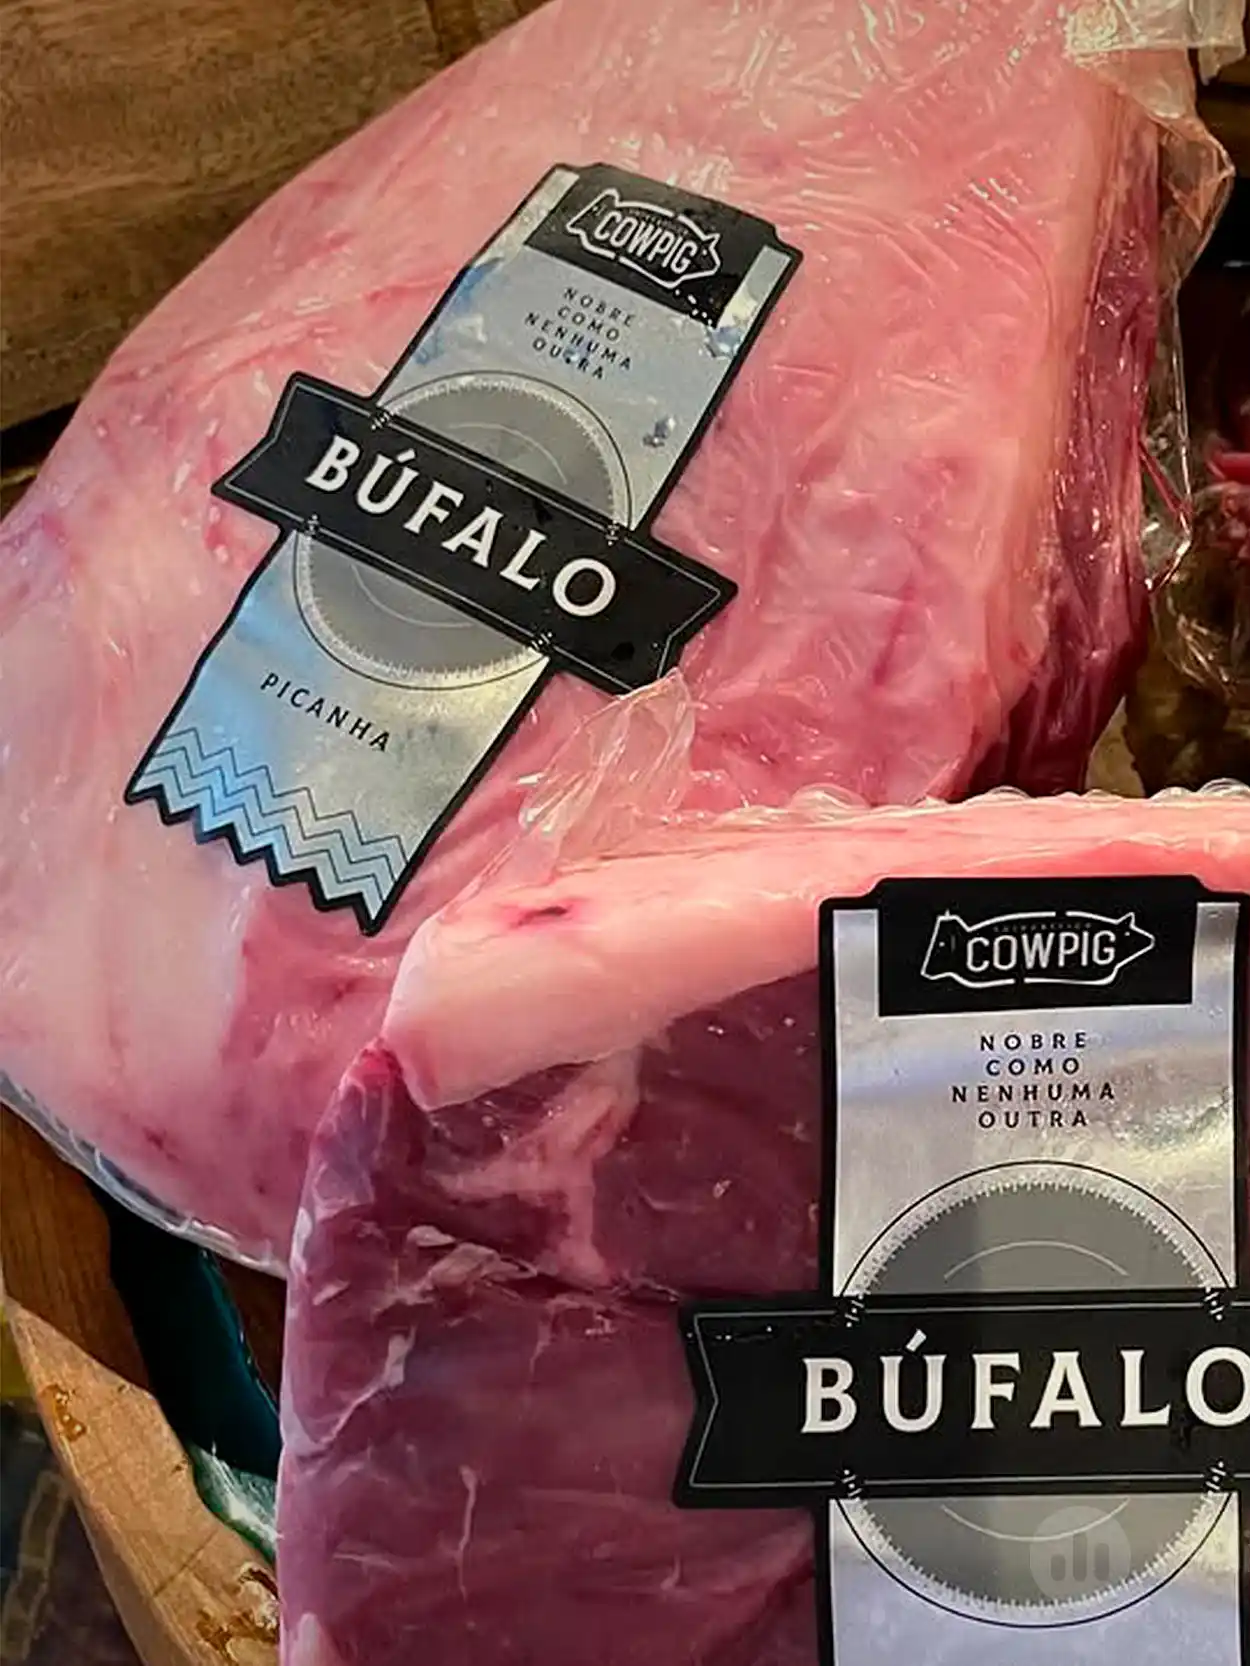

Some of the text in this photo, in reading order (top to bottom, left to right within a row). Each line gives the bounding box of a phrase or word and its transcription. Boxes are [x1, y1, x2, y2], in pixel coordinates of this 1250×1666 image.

[594, 211, 698, 274] COWPIG
[557, 306, 621, 342] COMO
[562, 287, 635, 328] NOBRE
[524, 312, 633, 371] NENHUMA
[305, 436, 617, 618] BÚFALO
[260, 671, 391, 753] PICANHA
[966, 930, 1116, 973] COWPIG
[980, 1031, 1088, 1051] NOBRE
[986, 1057, 1080, 1076] COMO
[951, 1081, 1115, 1103] NENHUMA
[978, 1109, 1089, 1128] OUTRA
